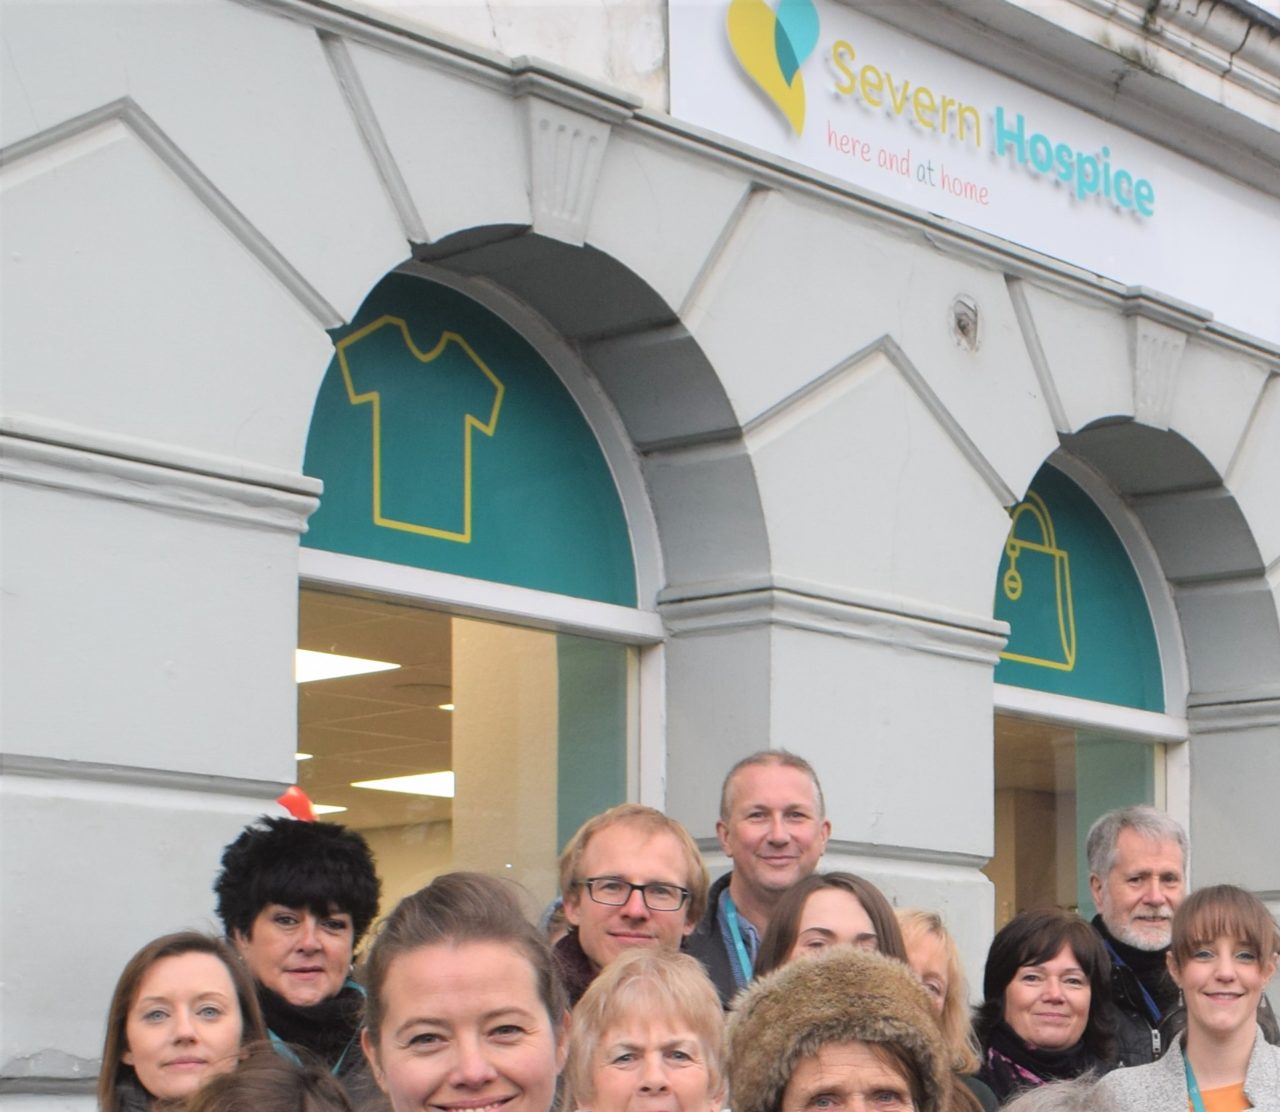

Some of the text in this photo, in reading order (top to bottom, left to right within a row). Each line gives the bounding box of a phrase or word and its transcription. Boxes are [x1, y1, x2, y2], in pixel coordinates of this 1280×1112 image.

[826, 120, 990, 206] here and at home
[832, 40, 1155, 217] Severn Hospice
